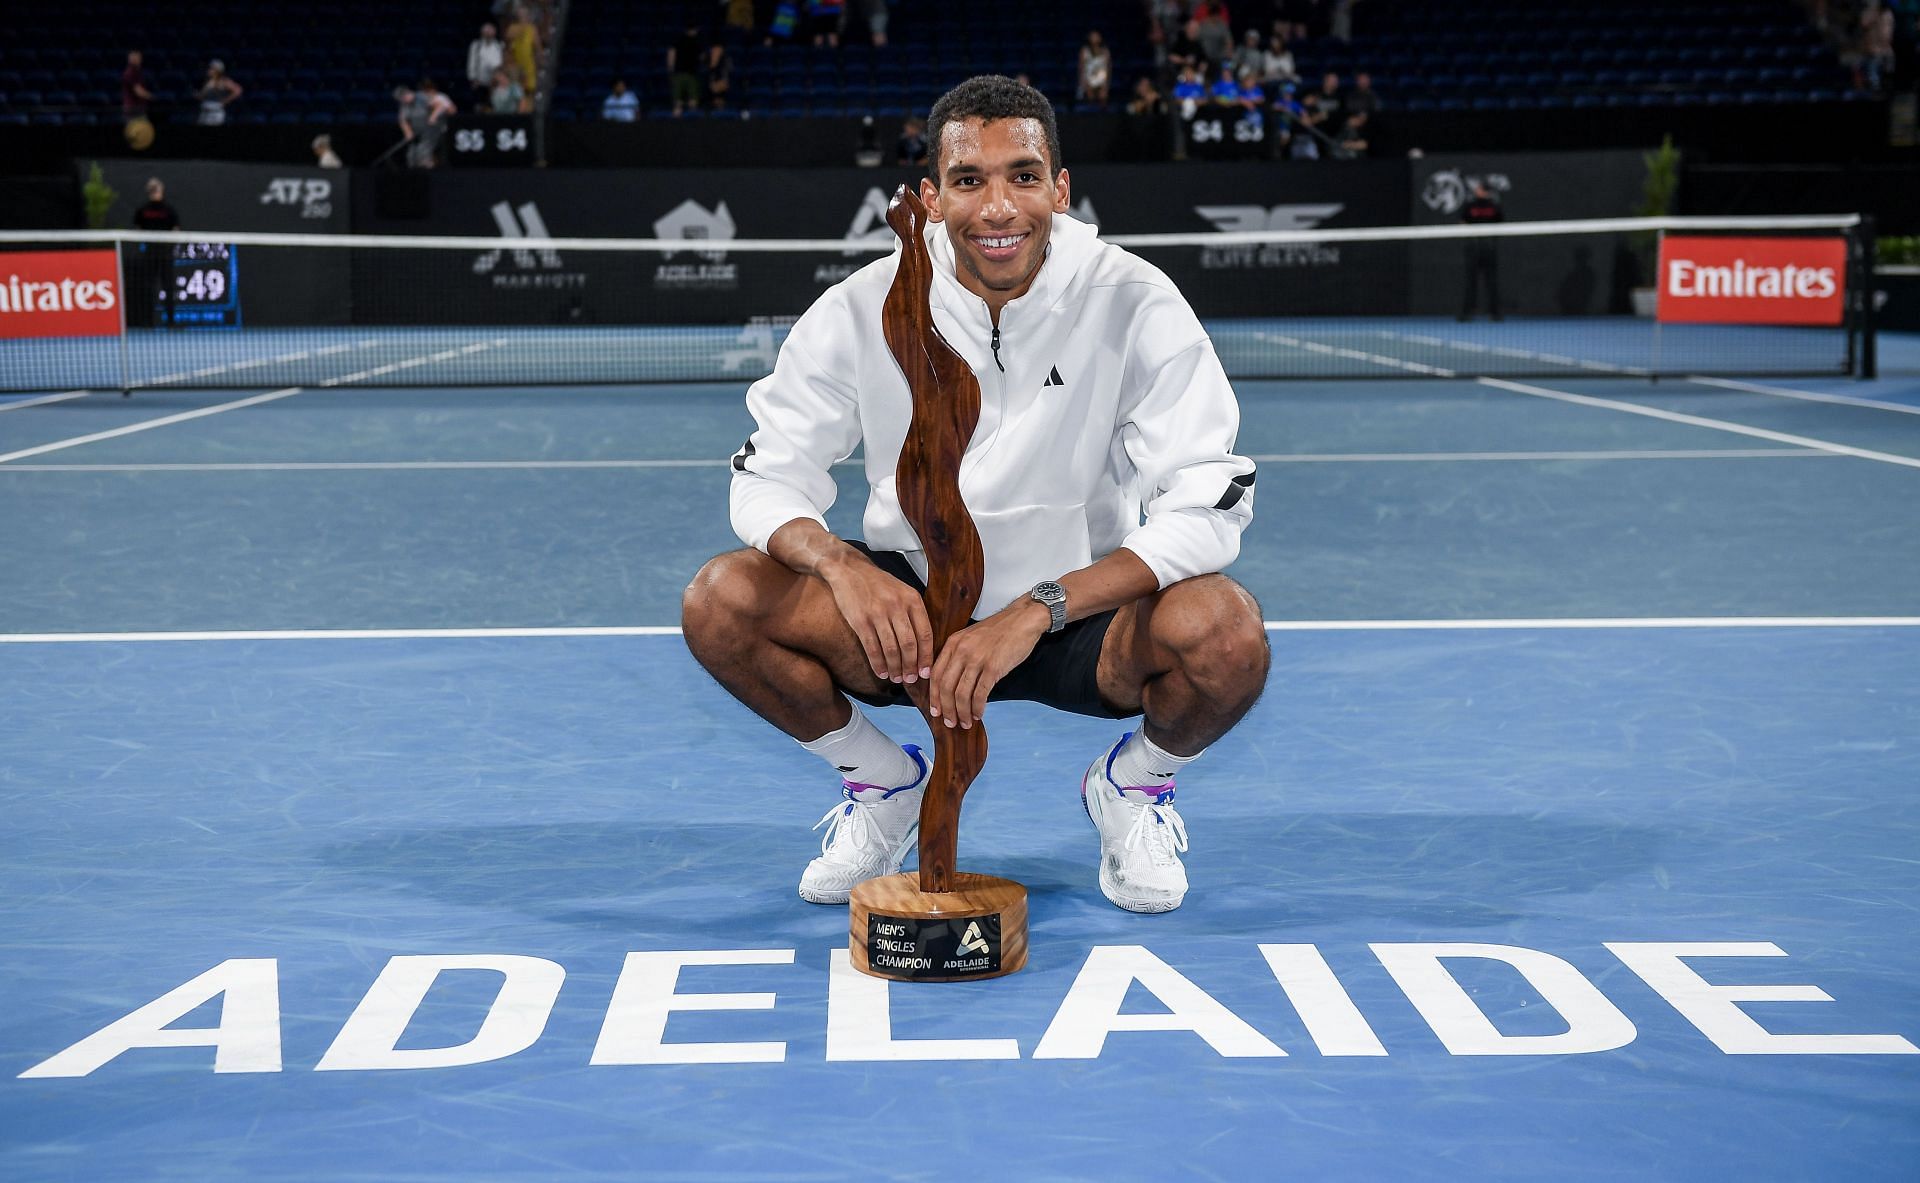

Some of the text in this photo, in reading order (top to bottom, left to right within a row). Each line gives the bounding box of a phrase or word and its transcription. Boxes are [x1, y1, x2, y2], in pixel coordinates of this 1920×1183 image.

[454, 128, 528, 152] S5 S4
[1191, 119, 1224, 143] S4
[260, 177, 332, 205] ATP
[175, 269, 225, 301] :49
[1669, 258, 1836, 298] Emirates
[0, 273, 115, 312] irates
[876, 923, 906, 937] MEN'S
[876, 938, 915, 953] SINGLES
[876, 954, 932, 969] CHAMPION
[943, 957, 990, 969] ADELAIDE
[18, 942, 1913, 1079] ADELAIDE
